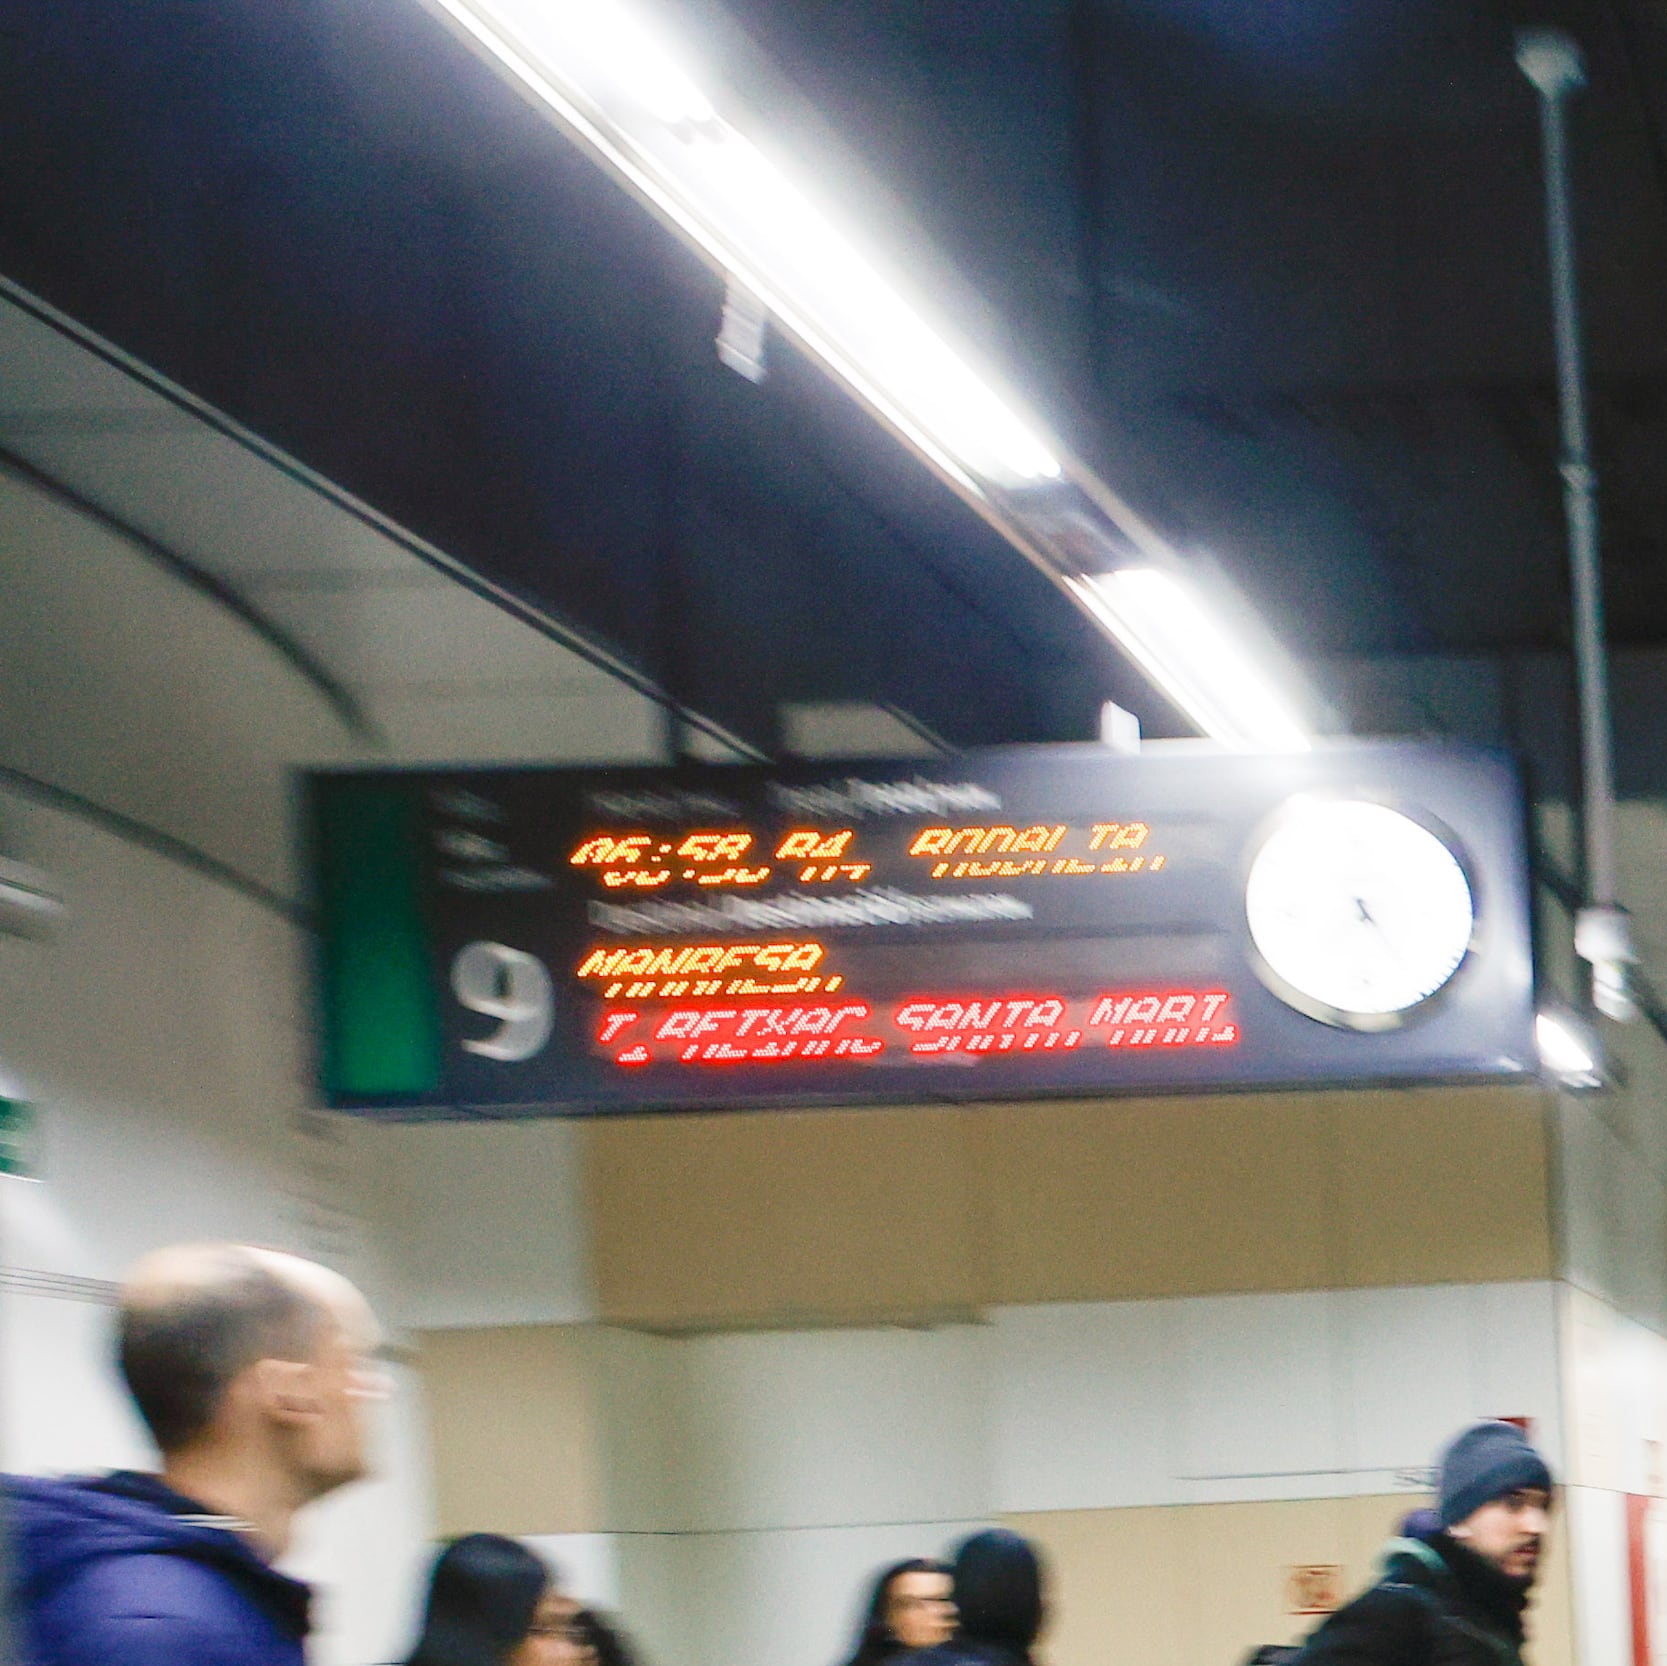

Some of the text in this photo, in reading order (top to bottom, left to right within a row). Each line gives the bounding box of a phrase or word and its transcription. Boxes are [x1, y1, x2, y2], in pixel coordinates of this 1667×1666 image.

[775, 830, 871, 882] R4
[577, 942, 843, 998] MANRESA
[452, 940, 554, 1063] 9
[896, 1000, 1081, 1053] SANTA
